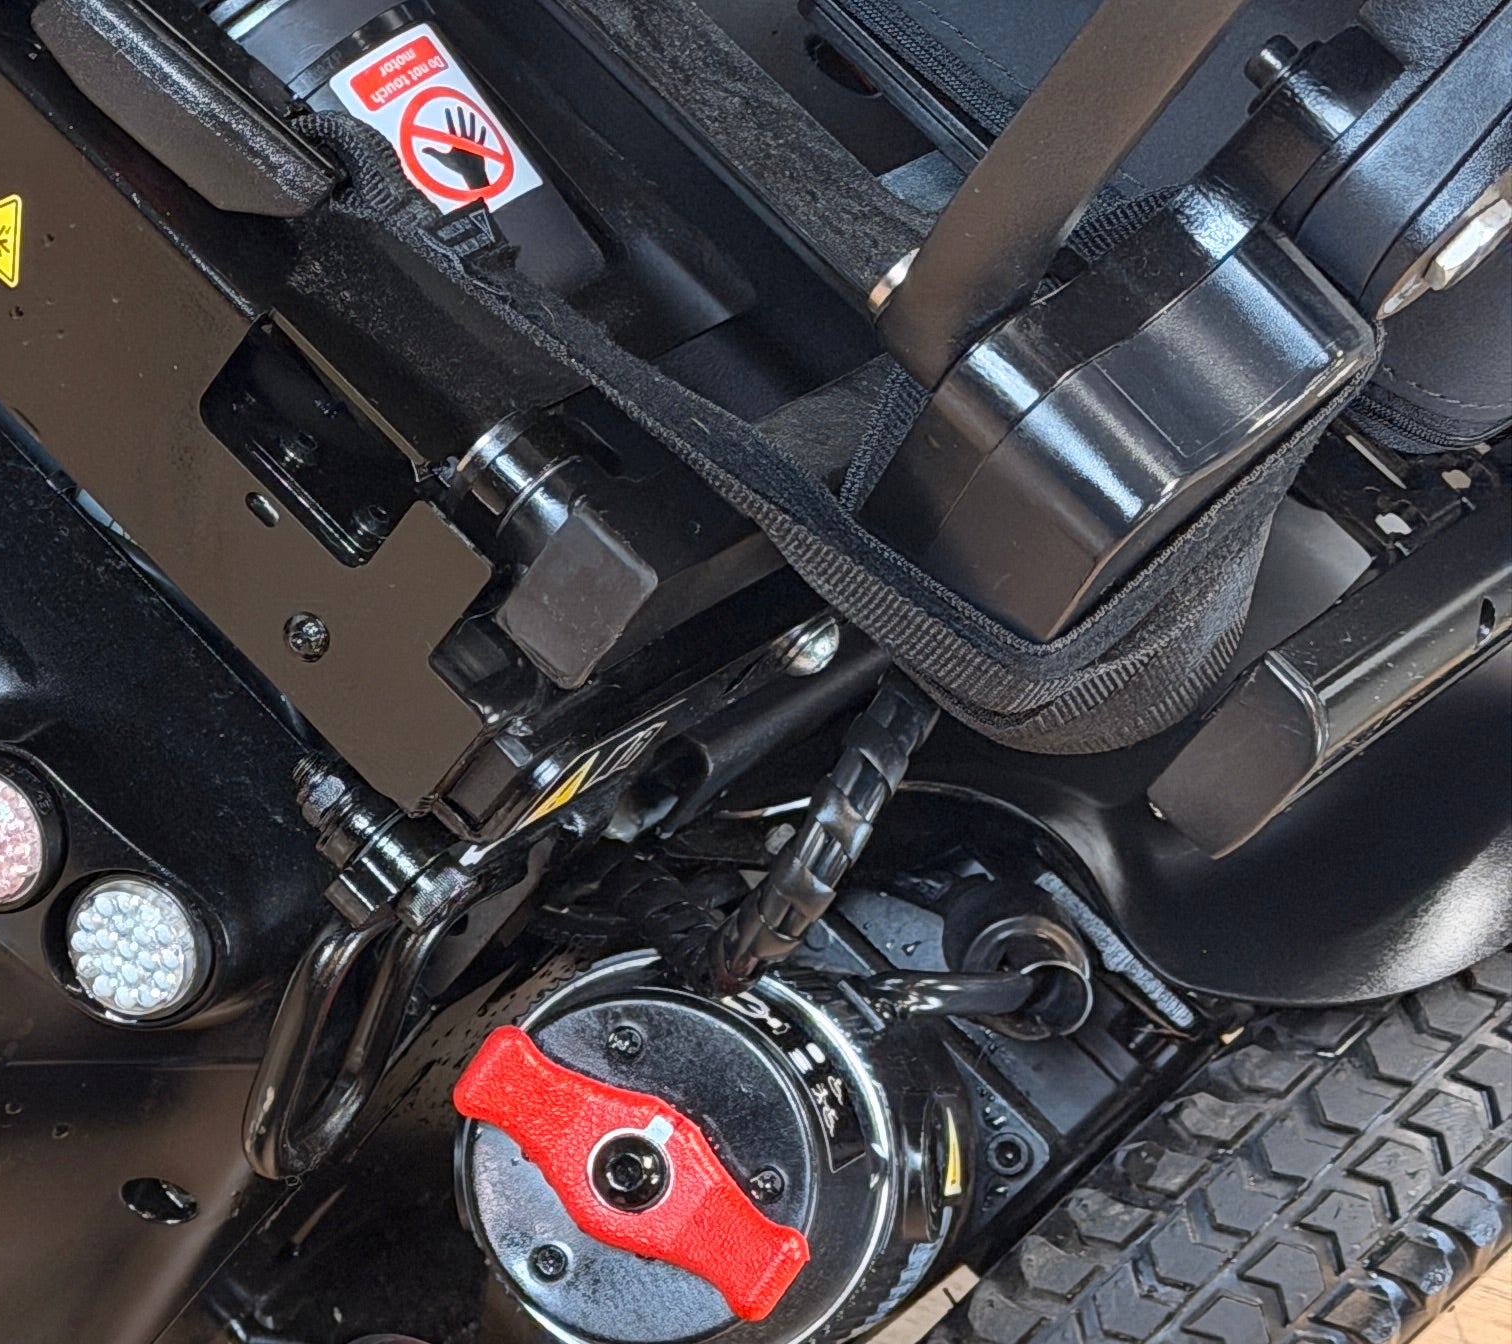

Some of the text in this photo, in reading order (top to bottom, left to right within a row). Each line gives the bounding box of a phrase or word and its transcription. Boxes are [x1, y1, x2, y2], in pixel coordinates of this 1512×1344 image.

[369, 55, 445, 104] Do not touch
[378, 48, 417, 78] motor
